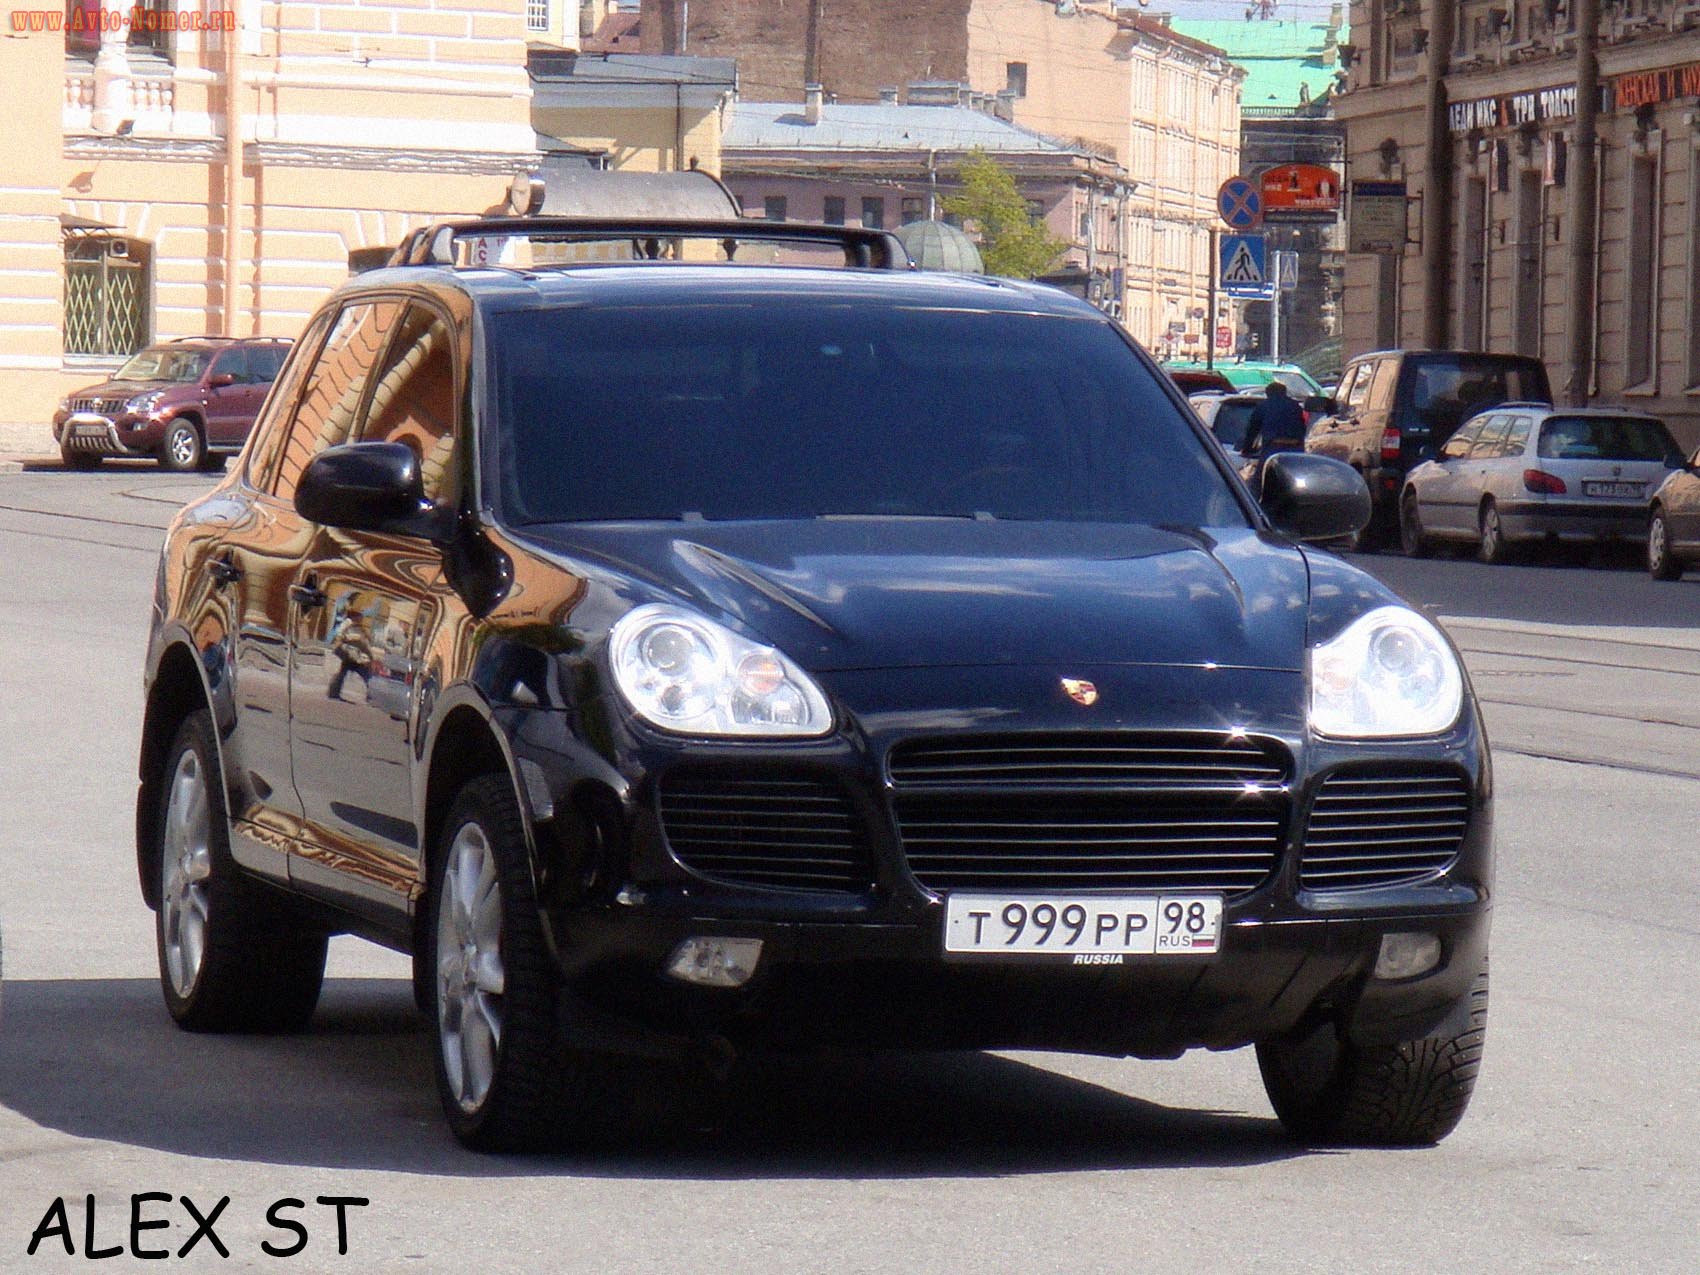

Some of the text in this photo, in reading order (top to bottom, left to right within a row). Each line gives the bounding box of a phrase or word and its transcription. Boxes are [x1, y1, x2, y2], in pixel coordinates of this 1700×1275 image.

[1513, 94, 1535, 123] ТРИ
[1164, 902, 1206, 933] 98
[1159, 935, 1191, 947] RUS
[1073, 954, 1124, 965] RUSSIA
